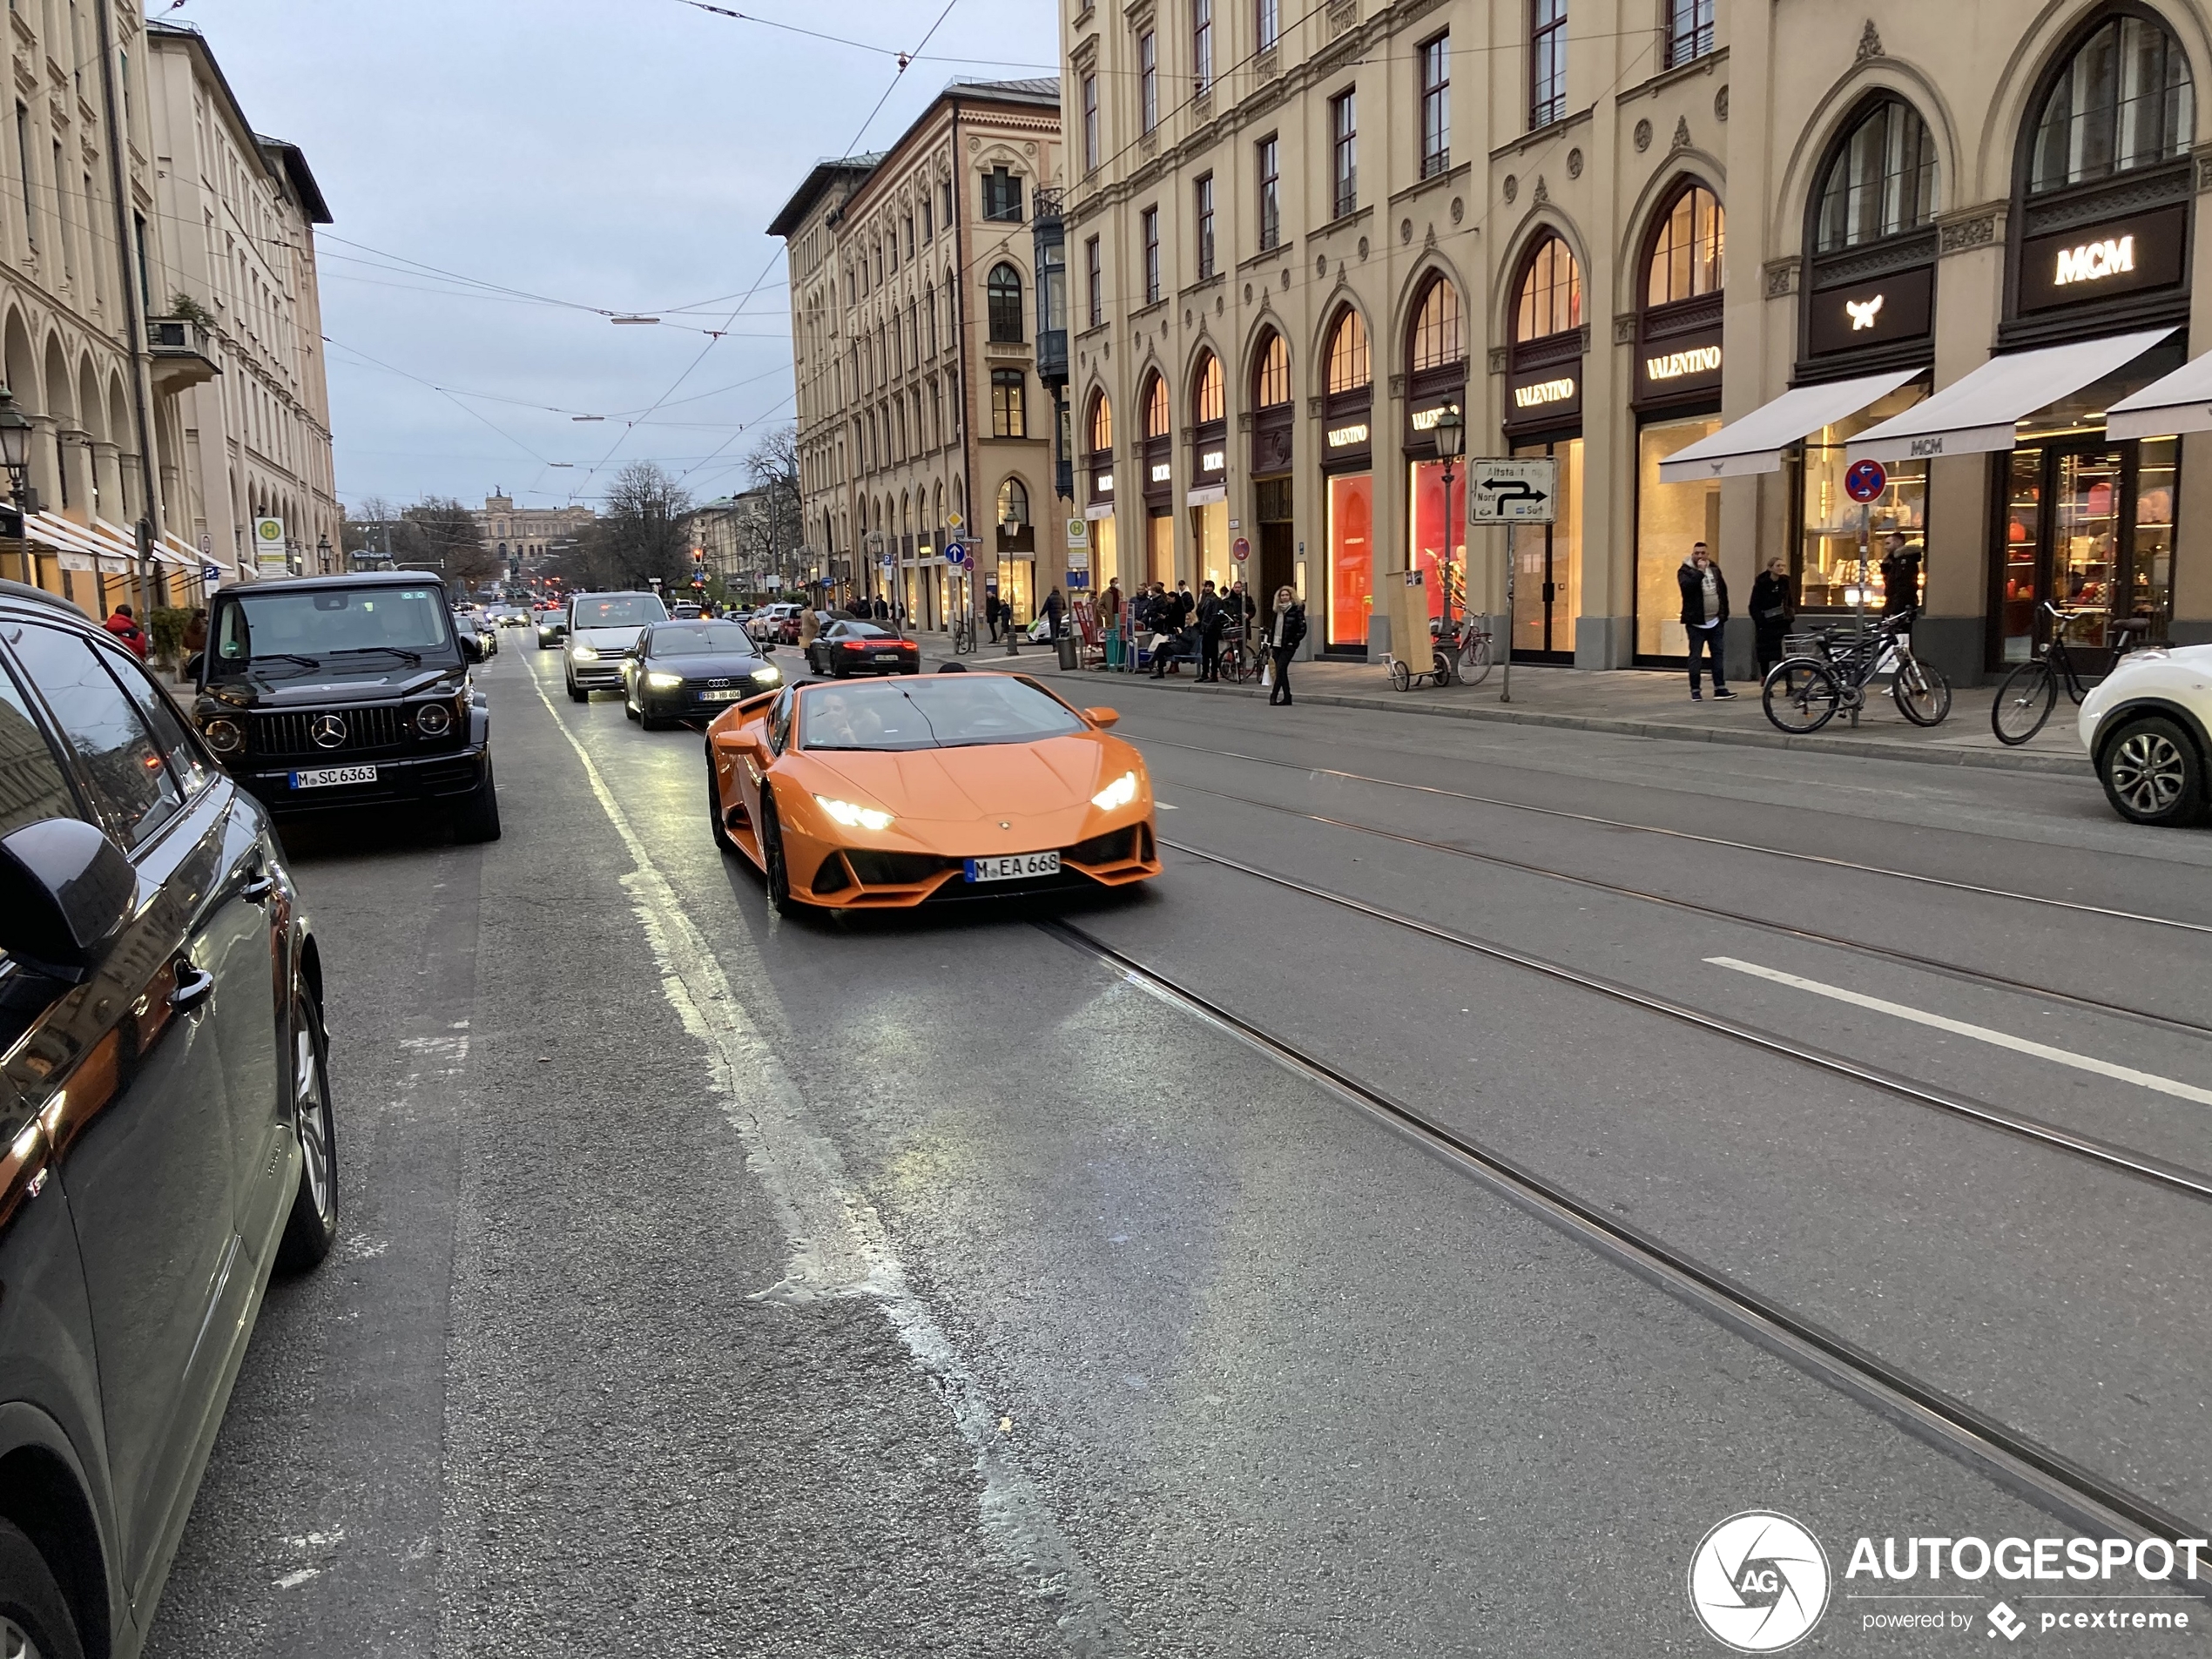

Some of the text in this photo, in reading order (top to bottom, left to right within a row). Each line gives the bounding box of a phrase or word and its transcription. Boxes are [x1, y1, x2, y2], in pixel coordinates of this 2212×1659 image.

[2054, 234, 2135, 286] MCM
[1646, 346, 1722, 381] VALENTINO
[1514, 377, 1575, 408] VALENTINO
[1327, 424, 1368, 448] VALENTINO
[1910, 437, 1943, 457] MCM
[1151, 463, 1171, 482] DIOR
[1203, 451, 1224, 472] DIOR
[1477, 492, 1497, 502] Nord
[298, 766, 375, 786] M SC 6363
[975, 853, 1058, 878] M EA 668
